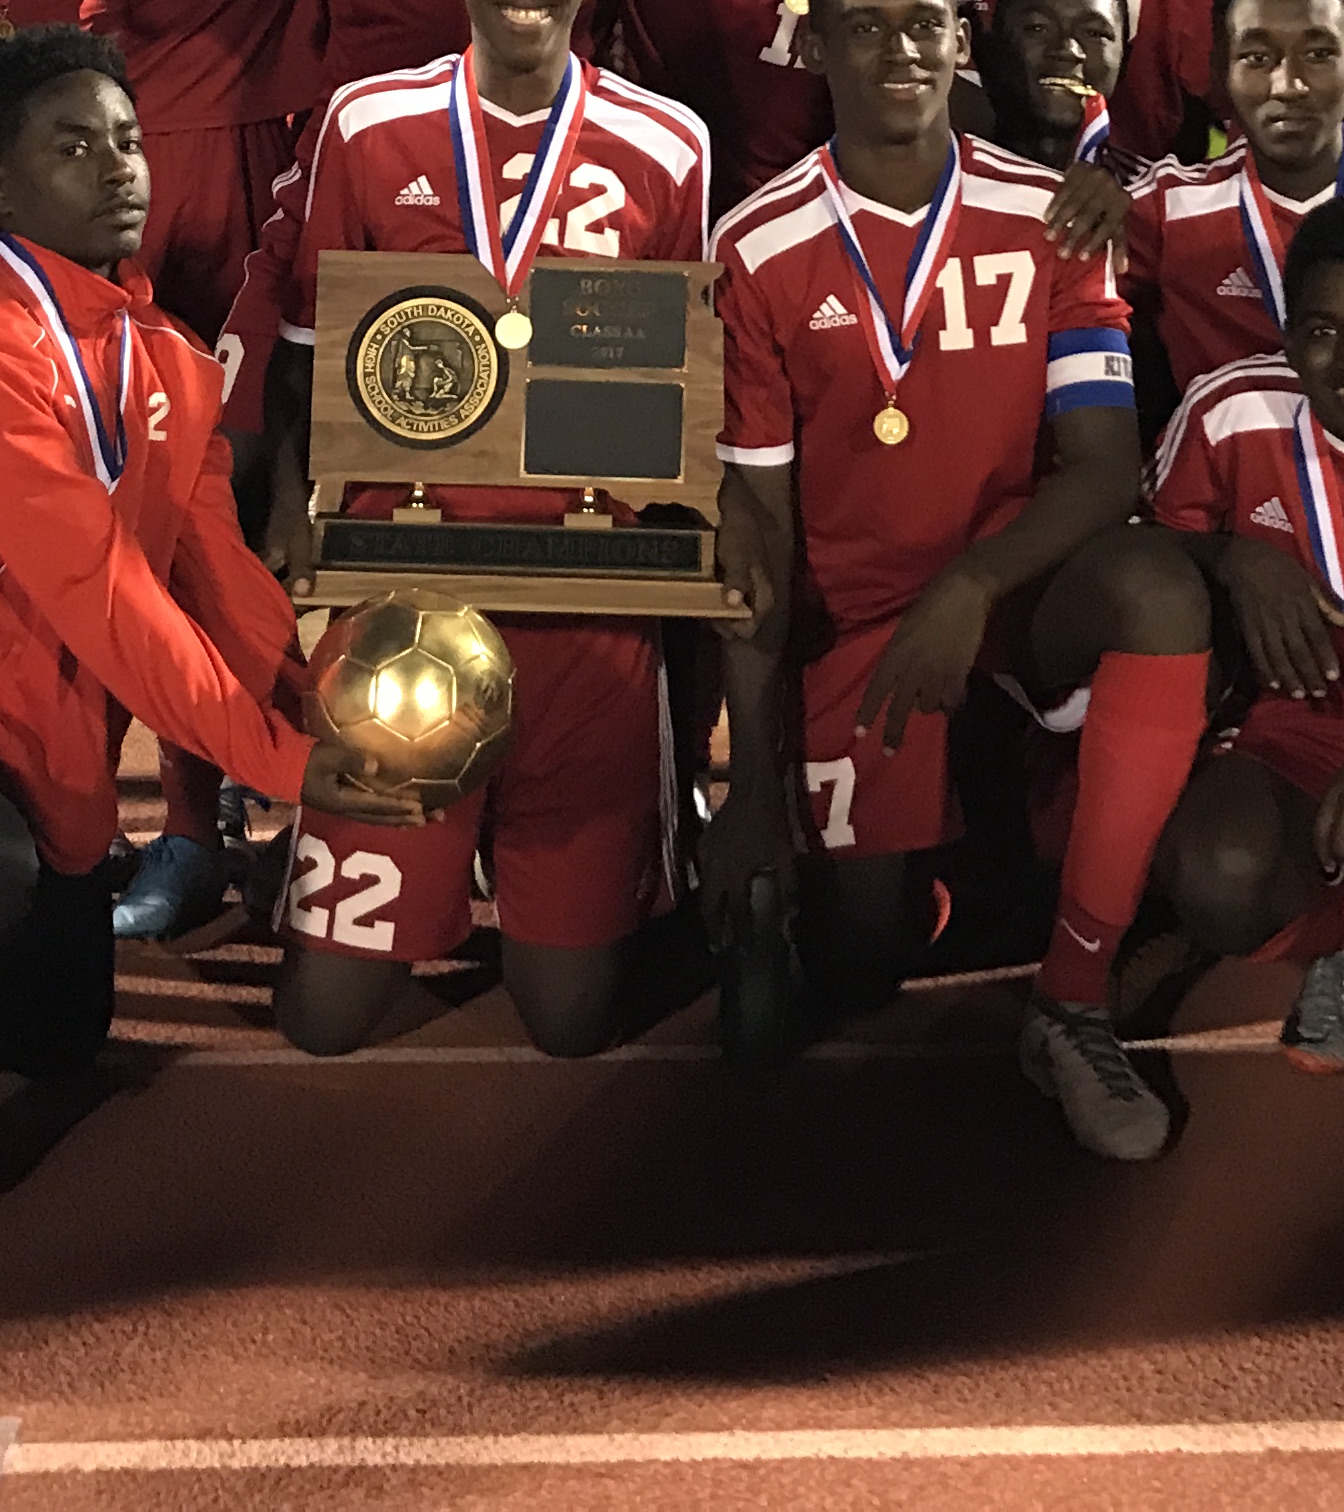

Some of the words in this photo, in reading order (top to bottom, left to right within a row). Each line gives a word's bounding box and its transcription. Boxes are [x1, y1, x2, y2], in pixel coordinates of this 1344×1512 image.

[394, 194, 441, 206] adidas
[935, 249, 1037, 352] 17
[1216, 285, 1263, 299] adidas
[380, 305, 423, 335] SOUTH
[428, 305, 477, 338] DAKOTA
[808, 313, 859, 331] adidas
[364, 342, 381, 373] HIGH
[460, 343, 492, 420] ASSOCIATION
[365, 374, 393, 421] SCHOOL
[395, 415, 459, 432] ACTIVITIES
[1249, 511, 1295, 534] adidas
[289, 833, 404, 953] 22
